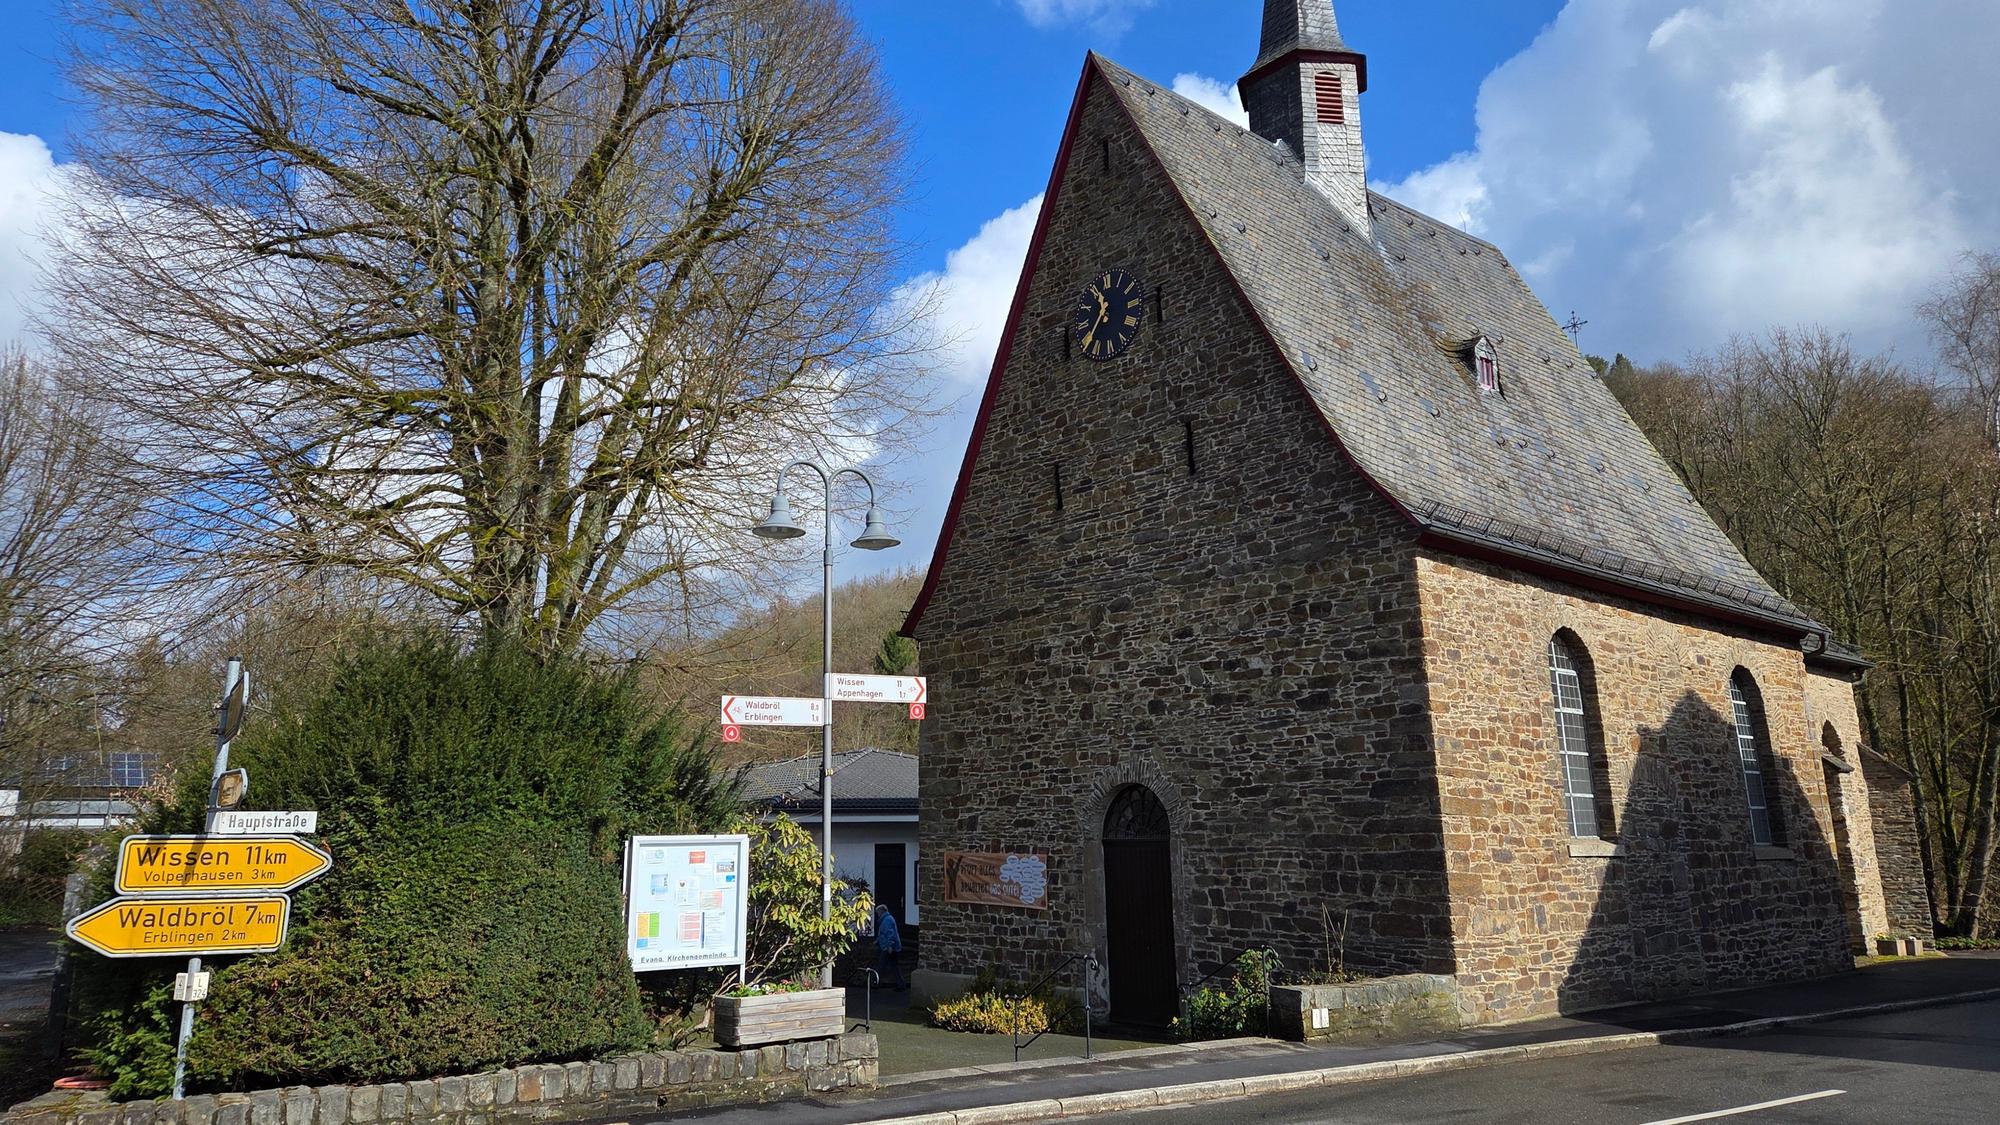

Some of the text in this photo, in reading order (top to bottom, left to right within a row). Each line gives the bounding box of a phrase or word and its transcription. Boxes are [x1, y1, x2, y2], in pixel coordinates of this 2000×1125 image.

[836, 677, 902, 688] Wissen 11
[836, 689, 883, 699] Appenhagen
[745, 701, 781, 710] Waldbröl
[744, 713, 783, 722] Erblingen
[228, 814, 308, 831] Hauptstraße
[136, 846, 230, 866] Wissen
[143, 870, 243, 882] Volperhausen
[119, 905, 234, 928] Waldbröl
[143, 930, 214, 945] Erblingen
